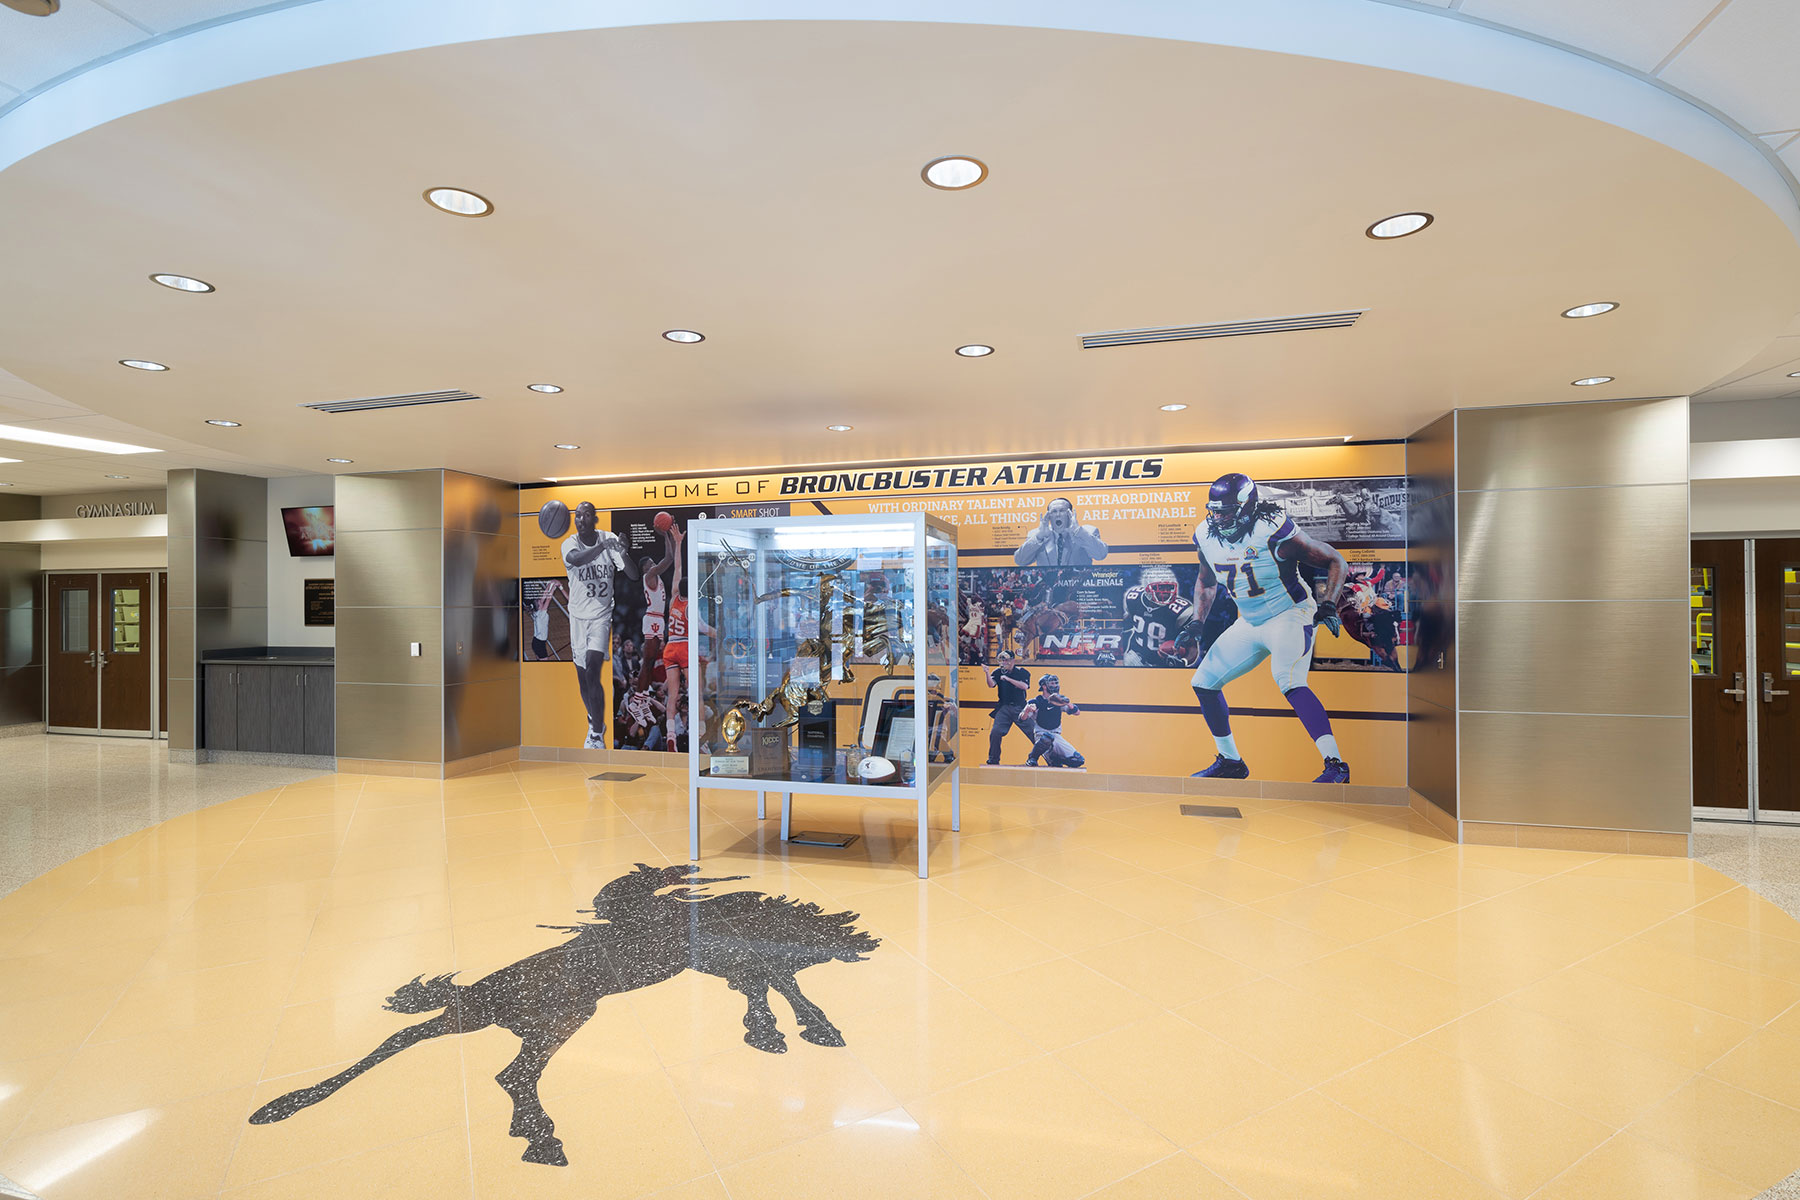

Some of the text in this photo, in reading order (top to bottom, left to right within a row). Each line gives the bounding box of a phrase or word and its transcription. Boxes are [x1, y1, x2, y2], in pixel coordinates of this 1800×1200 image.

[643, 457, 1163, 499] HOME OF BRONCBUSTER ATHLETICS
[76, 502, 157, 518] GYMNASIUM
[731, 507, 780, 518] SMART SHOT
[868, 491, 1192, 515] WITH ORDINARY TALENT AND EXTRAORDINARY
[964, 513, 988, 525] ALL
[989, 511, 1037, 524] THINGS
[1082, 509, 1110, 521] ARE
[1114, 506, 1197, 520] ATTAINABLE
[578, 563, 614, 582] KANSAS
[1214, 563, 1266, 598] 71
[586, 581, 609, 598] 32
[1169, 599, 1188, 614] 28
[668, 616, 685, 635] 25
[1133, 615, 1166, 651] 28
[1043, 634, 1122, 649] NFR
